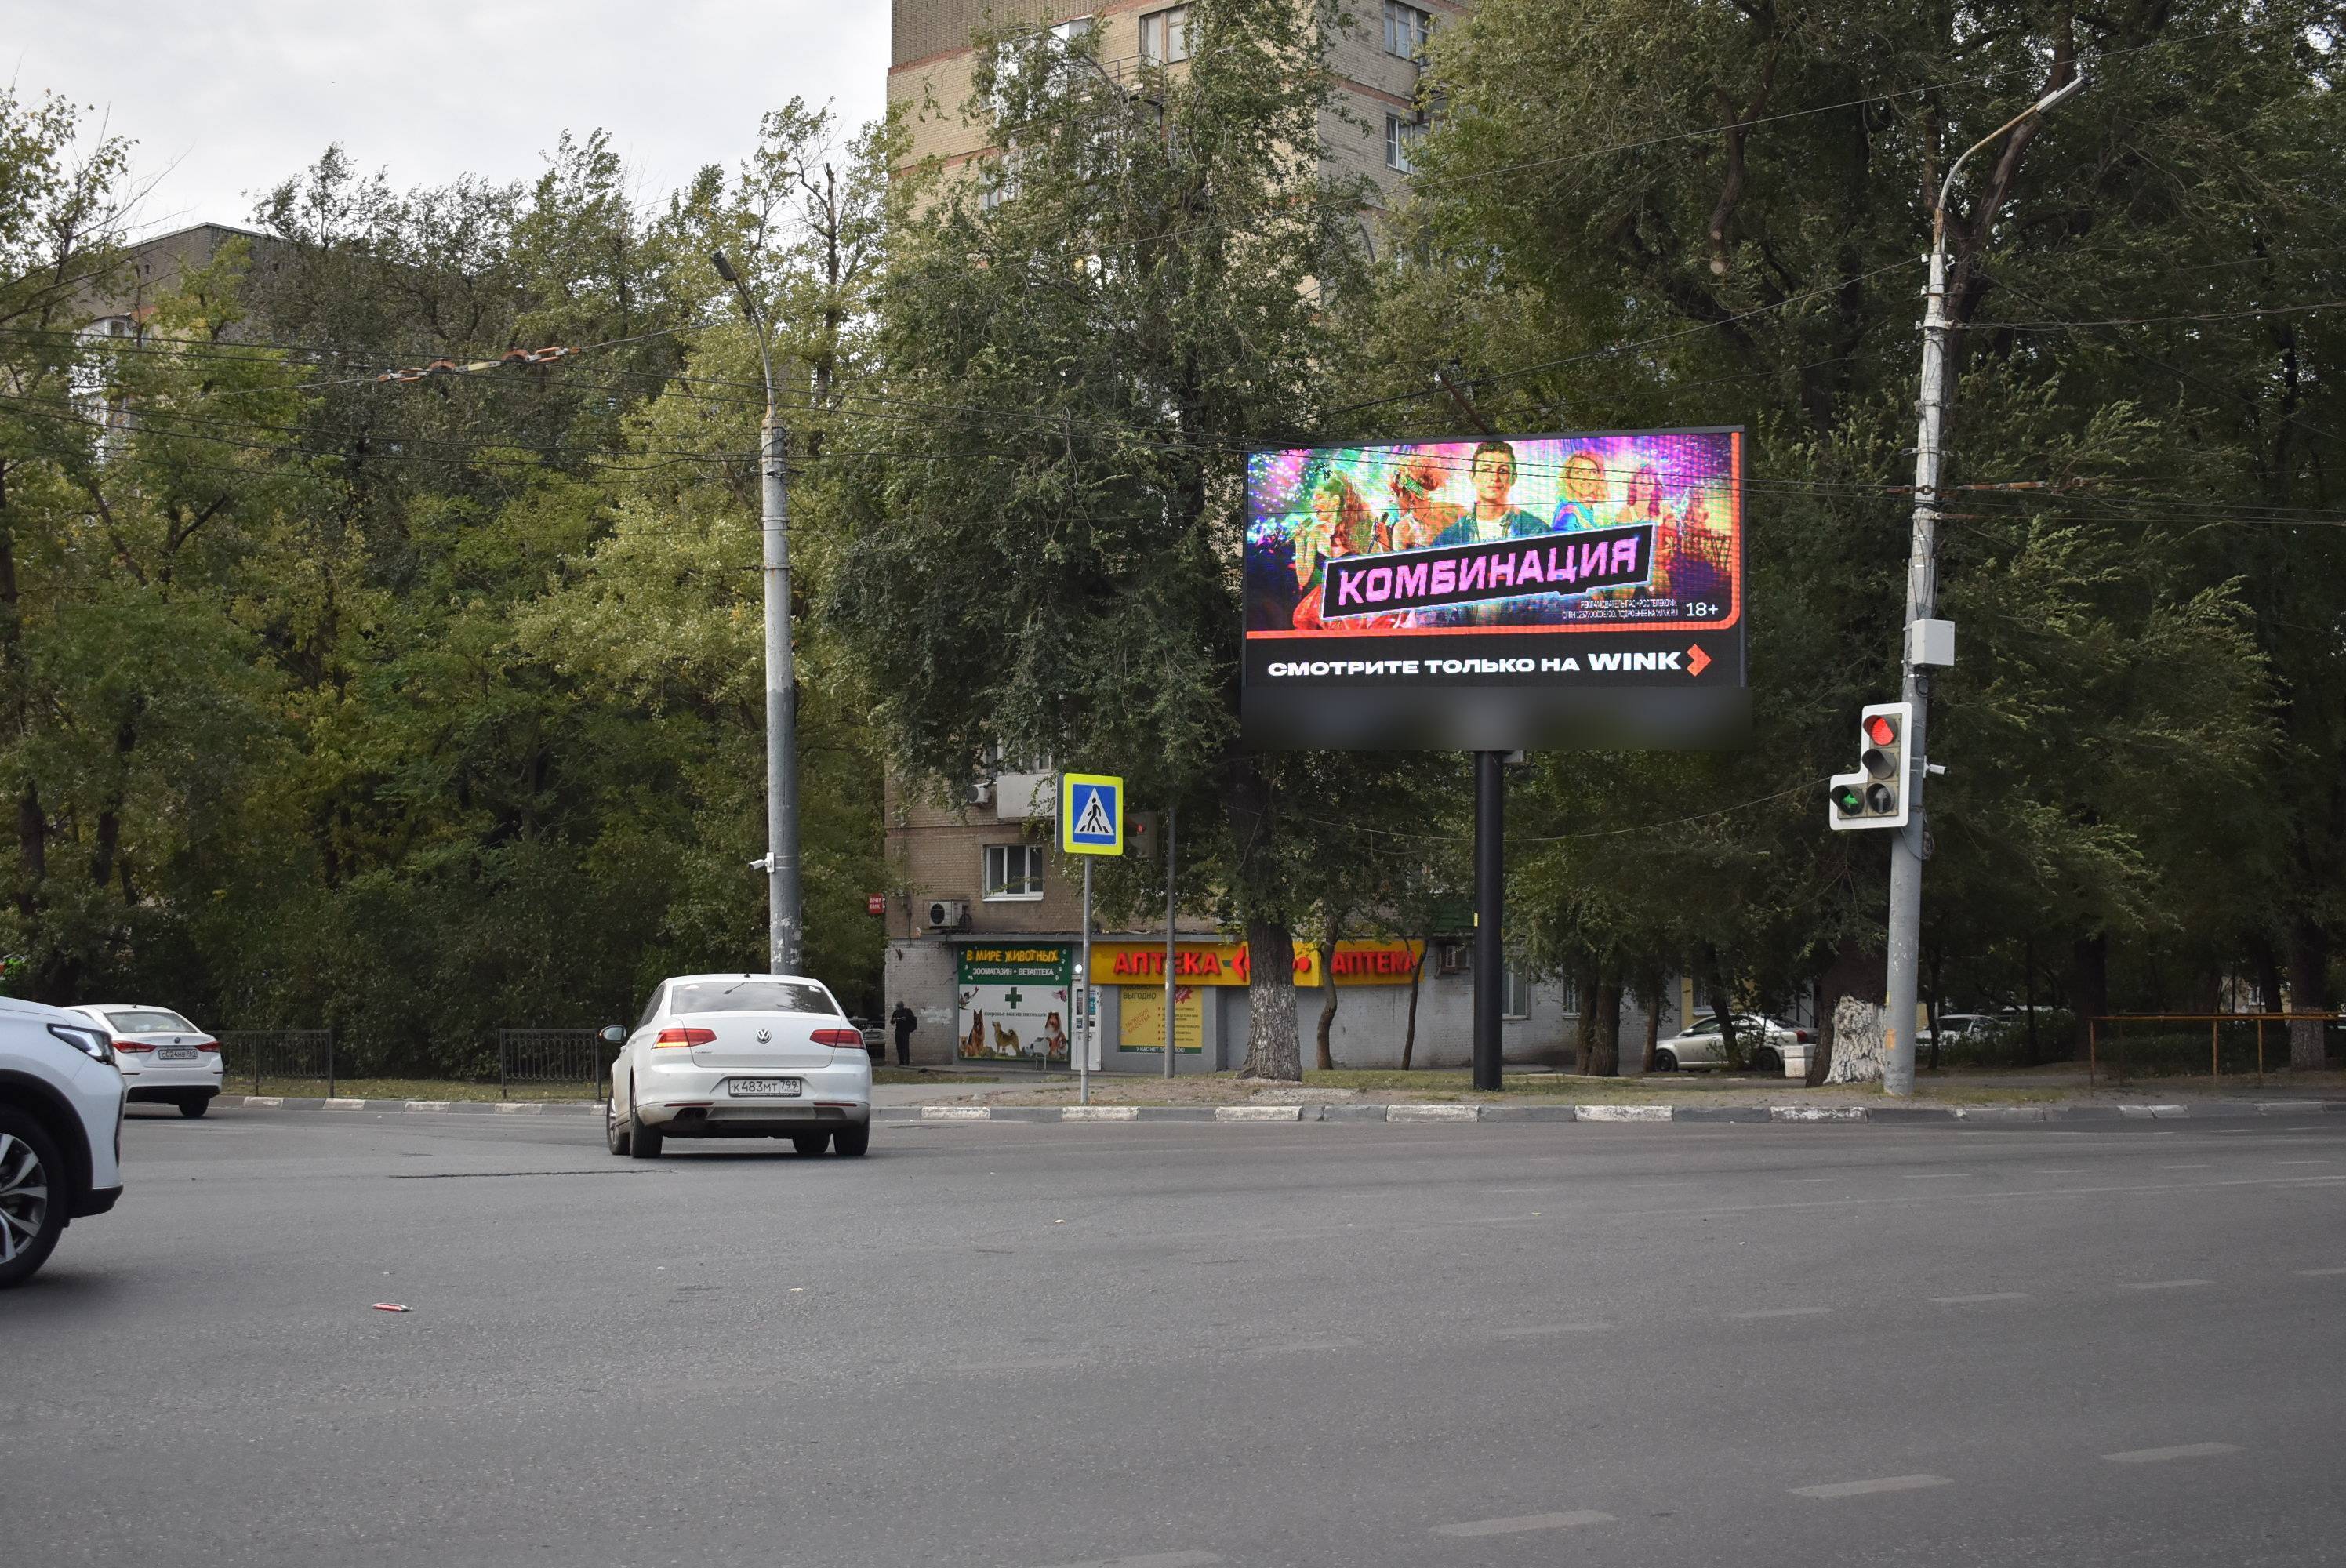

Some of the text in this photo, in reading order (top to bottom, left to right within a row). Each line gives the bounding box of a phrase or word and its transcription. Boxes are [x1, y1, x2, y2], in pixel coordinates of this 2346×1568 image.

[1338, 538, 1640, 606] КОМБИНАЦИЯ
[1686, 602, 1718, 617] 18+
[1267, 652, 1681, 677] СМОТРИТЕ ТОЛЬКО НА WINK
[966, 949, 1059, 962] В МИРЕ ЖИВОТНЫХ
[1114, 952, 1221, 975] АПТЕКА
[1331, 950, 1418, 974] АПТЕКА
[1123, 993, 1157, 1001] ВЫГОДНО
[780, 1080, 797, 1089] 799
